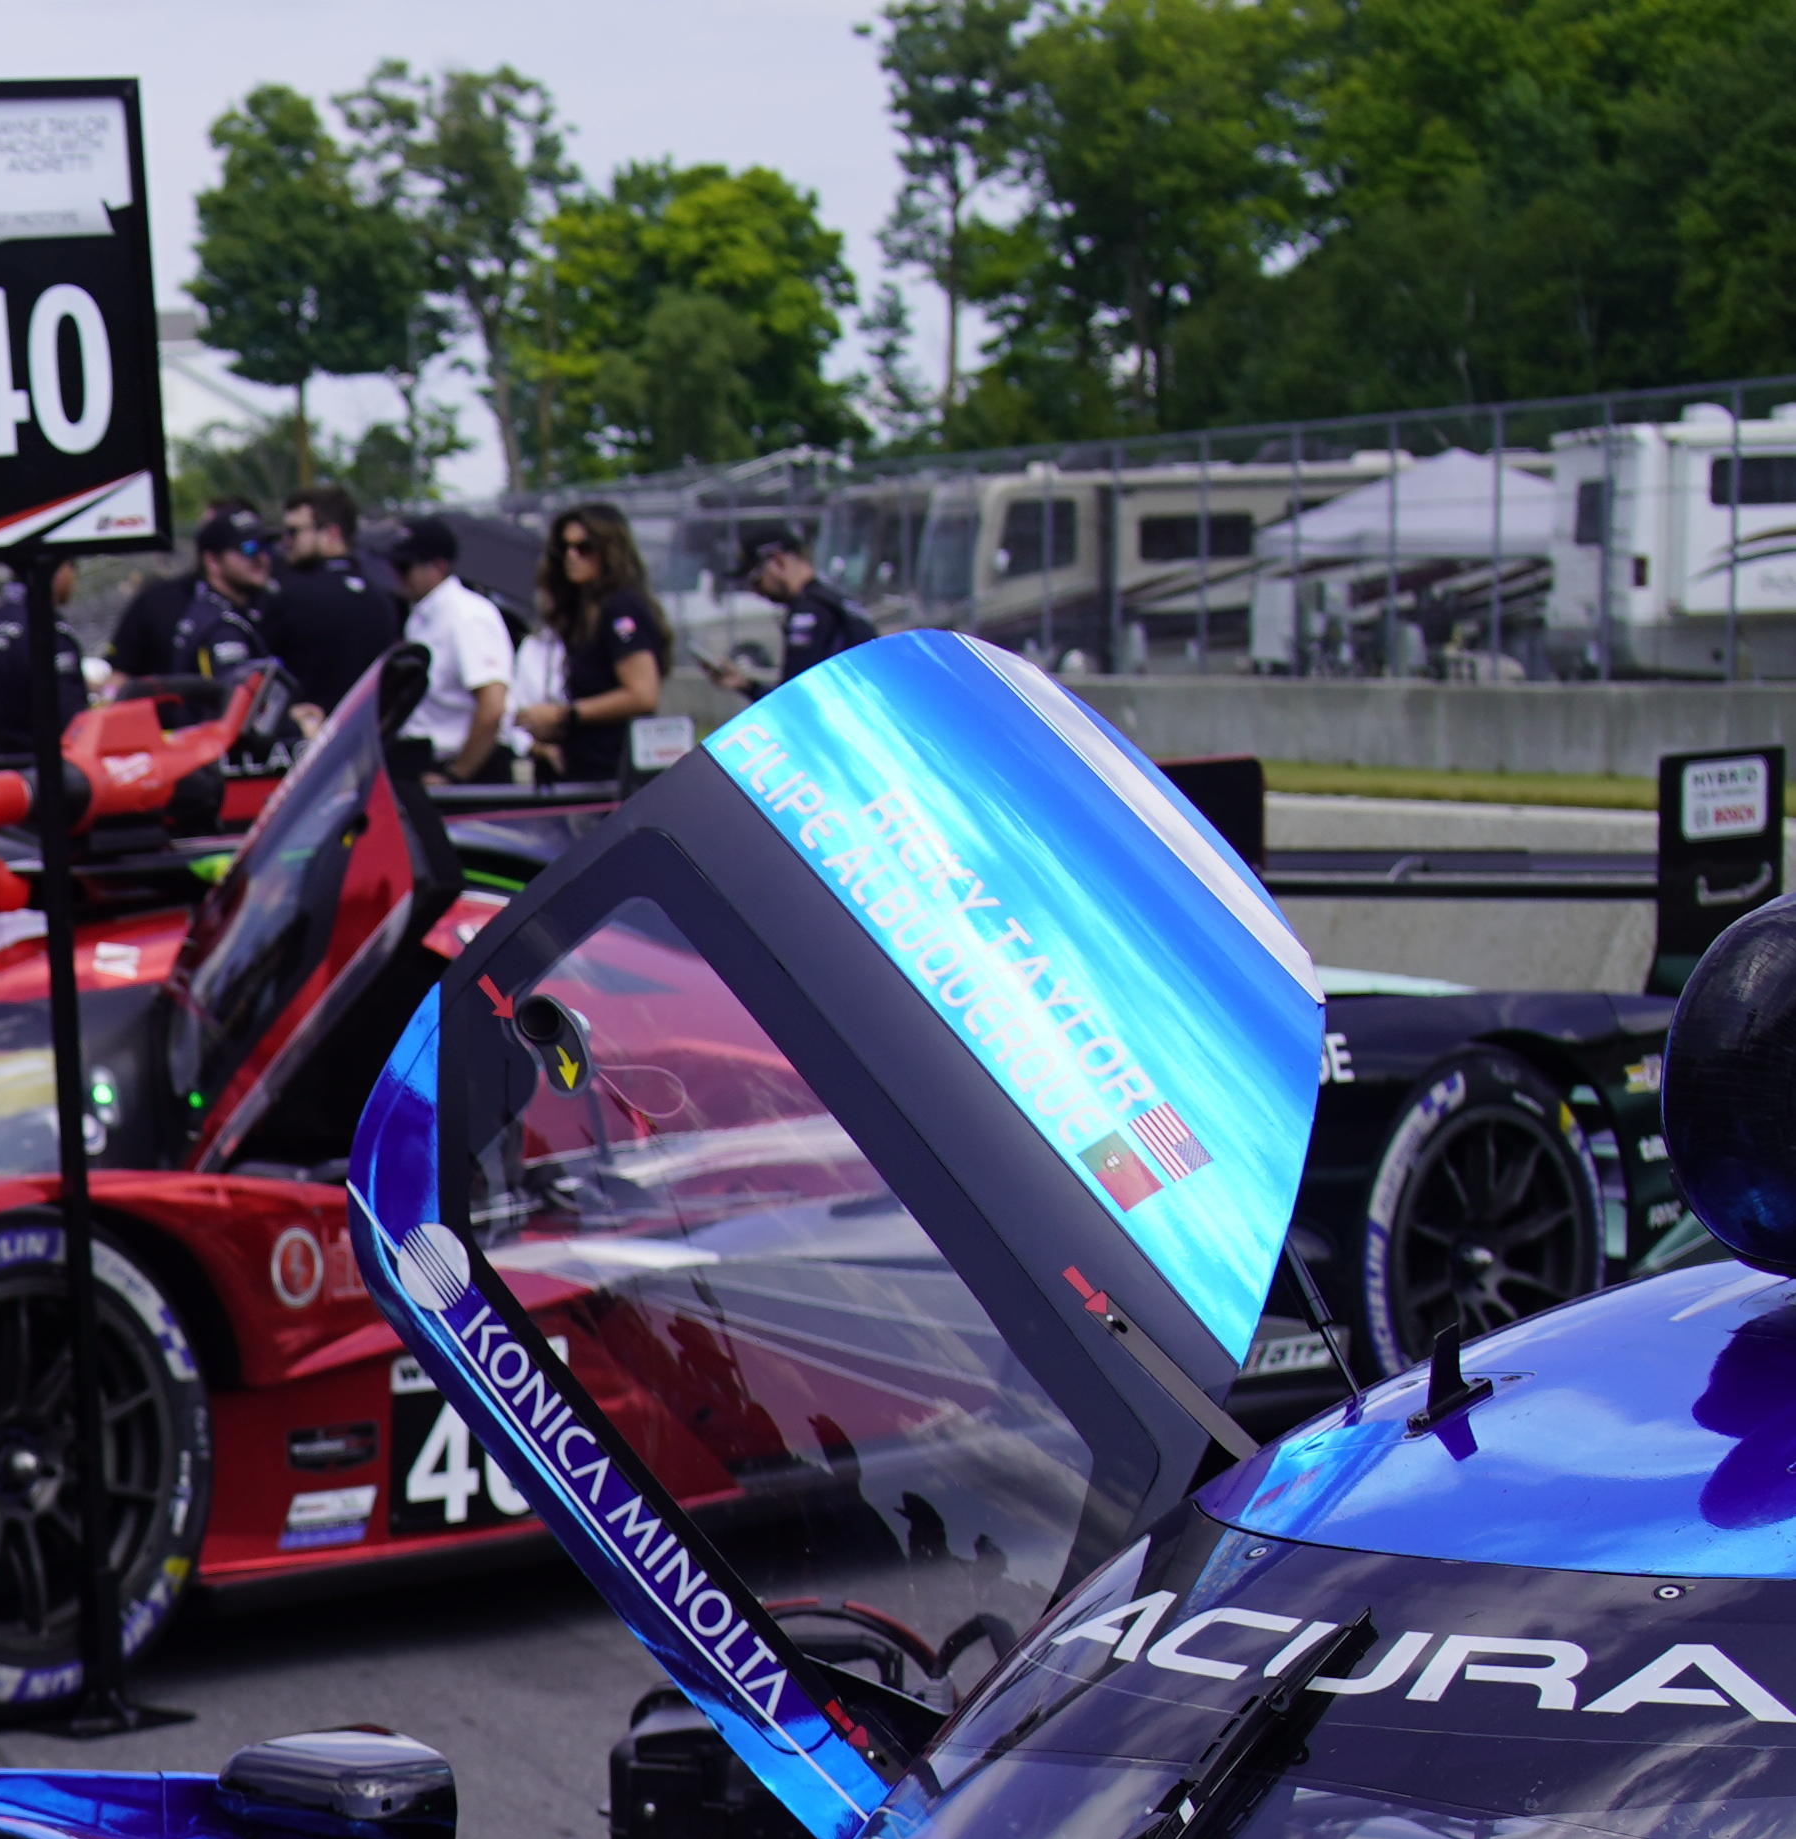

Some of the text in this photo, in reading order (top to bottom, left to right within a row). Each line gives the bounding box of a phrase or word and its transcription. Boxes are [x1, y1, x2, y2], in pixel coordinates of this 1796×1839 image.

[716, 722, 1109, 1146] FILIPE ALBUQUERQUE
[857, 788, 1155, 1115] RICKY TAYLOR
[460, 1304, 790, 1719] KONICA MINOLTA
[1050, 1589, 1796, 1724] ACURA
